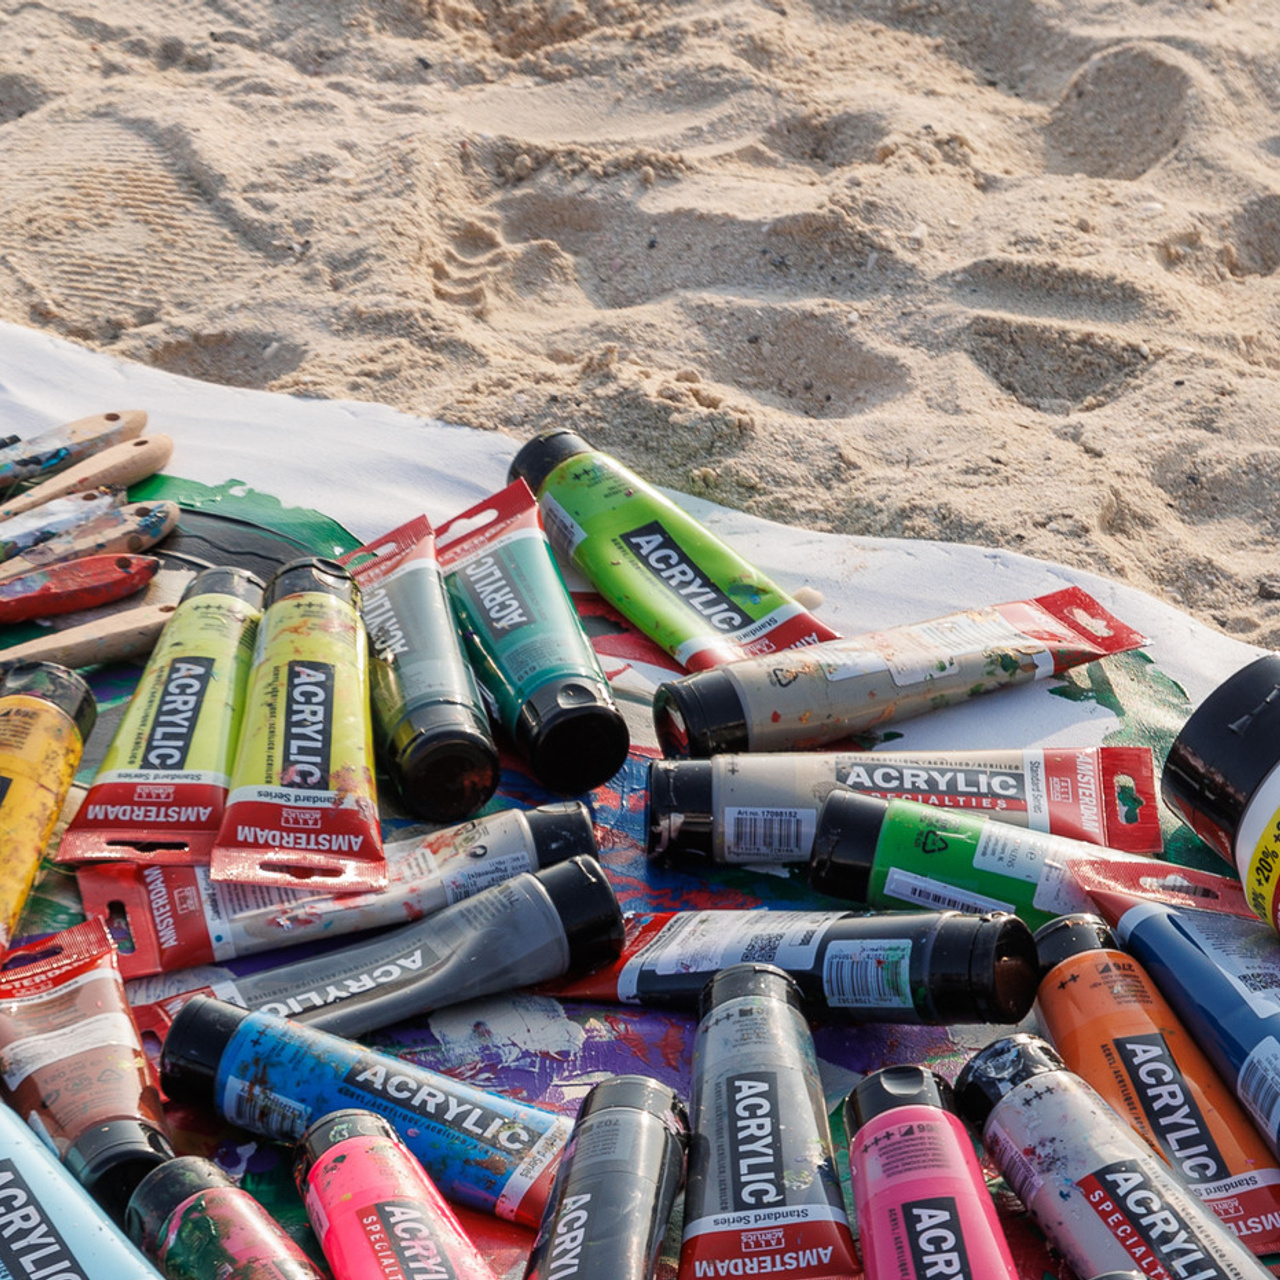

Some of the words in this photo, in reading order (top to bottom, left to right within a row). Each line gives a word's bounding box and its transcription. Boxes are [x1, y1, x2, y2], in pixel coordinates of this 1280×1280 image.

[465, 556, 528, 629] ACRYLIC
[630, 533, 742, 630] ACRYLIC
[147, 661, 205, 765] ACRYLIC
[291, 665, 326, 787] ACRYLIC
[87, 805, 213, 822] AMSTERDAM
[257, 789, 289, 801] Series
[846, 766, 1018, 796] ACRYLIC
[1076, 752, 1100, 833] AMSTERDAM
[237, 825, 364, 851] AMSTERDAM
[144, 867, 178, 949] AMSTERDAM
[356, 1066, 531, 1149] ACRYLIC
[734, 1080, 778, 1205] ACRYLIC
[1126, 1042, 1218, 1180] ACRYLIC
[714, 1215, 751, 1227] Series
[755, 1209, 809, 1221] Standard
[1203, 1176, 1258, 1197] Standard
[695, 1245, 834, 1278] AMSTERDAM
